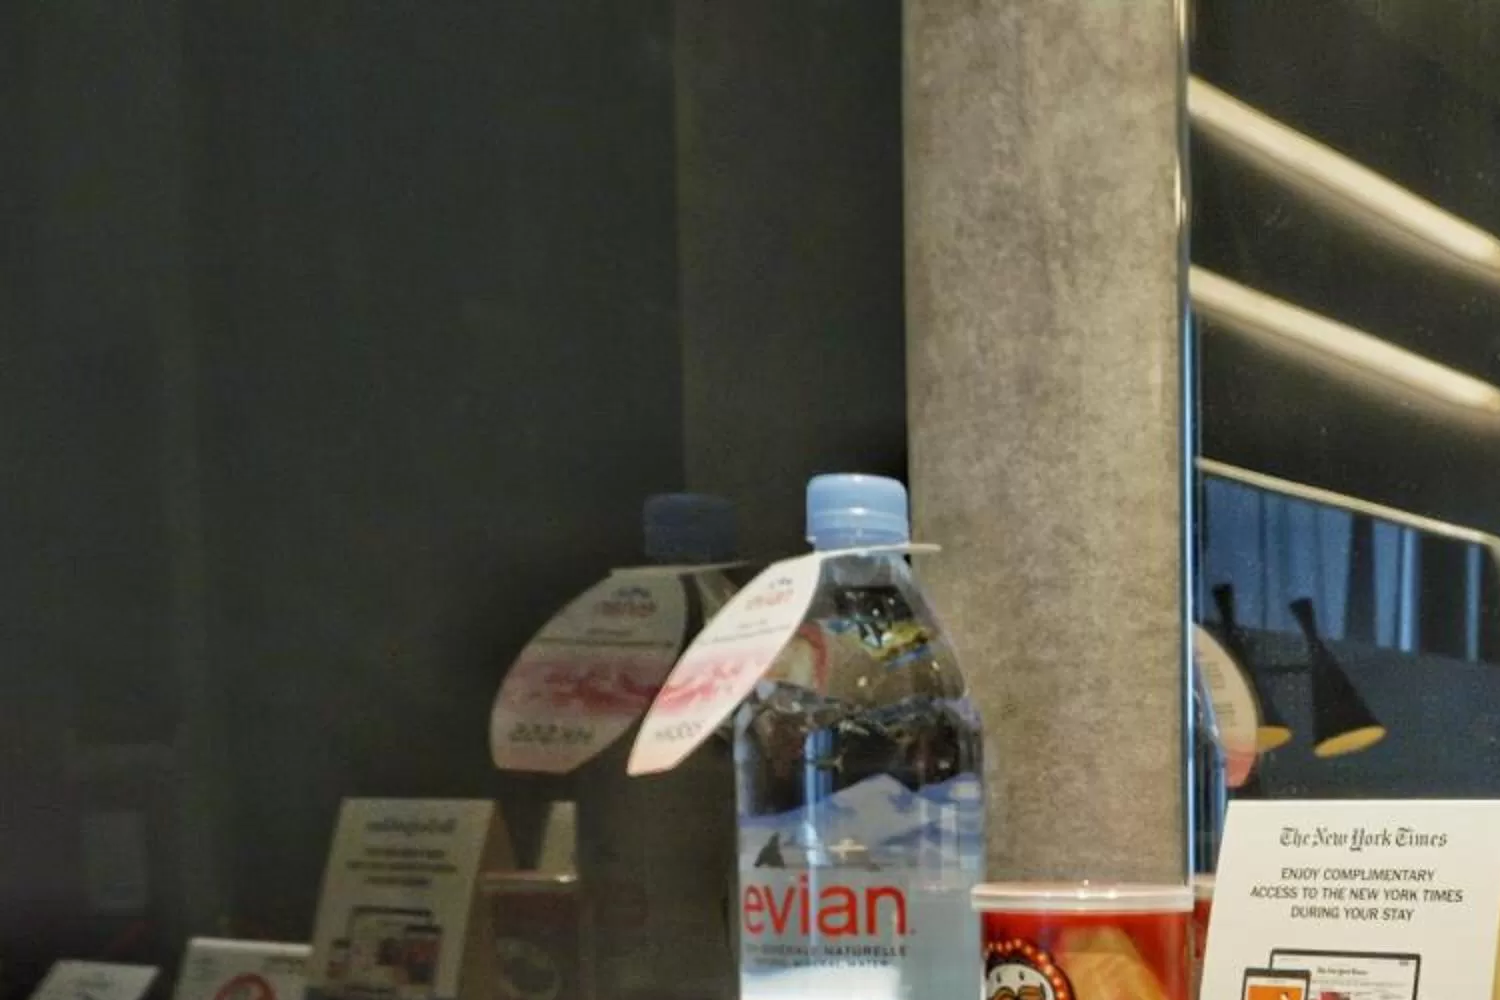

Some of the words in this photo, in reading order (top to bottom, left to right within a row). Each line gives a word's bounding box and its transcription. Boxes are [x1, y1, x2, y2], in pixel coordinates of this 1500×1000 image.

[1280, 827, 1309, 848] The
[1311, 827, 1348, 848] New
[1349, 827, 1393, 852] York
[1395, 827, 1448, 848] Times
[1280, 867, 1320, 881] ENJOY
[1323, 867, 1435, 882] COMPLIMENTARY
[1250, 885, 1298, 900] ACCESS
[1302, 886, 1319, 900] TO
[1322, 887, 1346, 901] THE
[1349, 887, 1379, 901] NEW
[1383, 888, 1417, 902] YORK
[1422, 888, 1463, 903] TIMES
[743, 873, 908, 936] evian
[1290, 905, 1340, 919] DURING
[1343, 906, 1379, 921] YOUR
[1382, 907, 1415, 922] STAY
